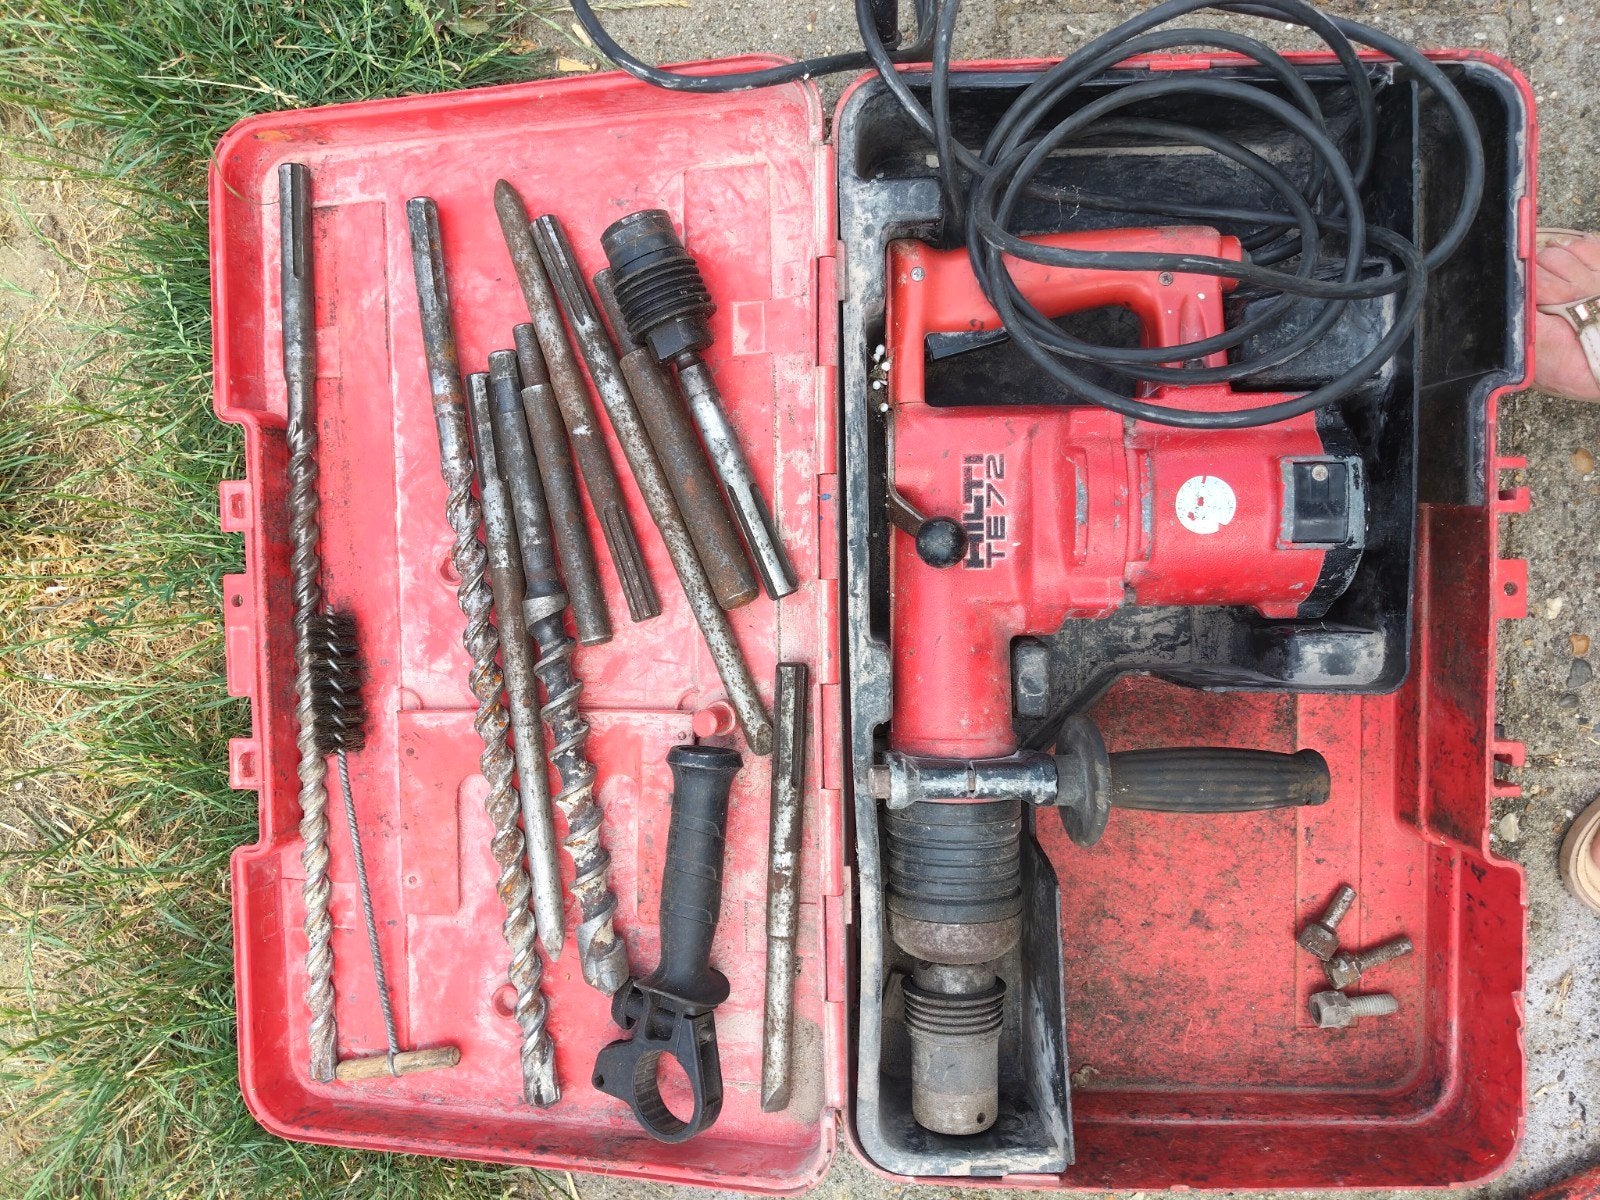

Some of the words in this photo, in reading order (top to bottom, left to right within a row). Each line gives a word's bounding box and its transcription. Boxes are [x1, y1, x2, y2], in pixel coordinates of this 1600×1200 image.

[986, 454, 1004, 508] 72
[963, 454, 984, 569] HILTI
[986, 515, 1005, 568] TE
